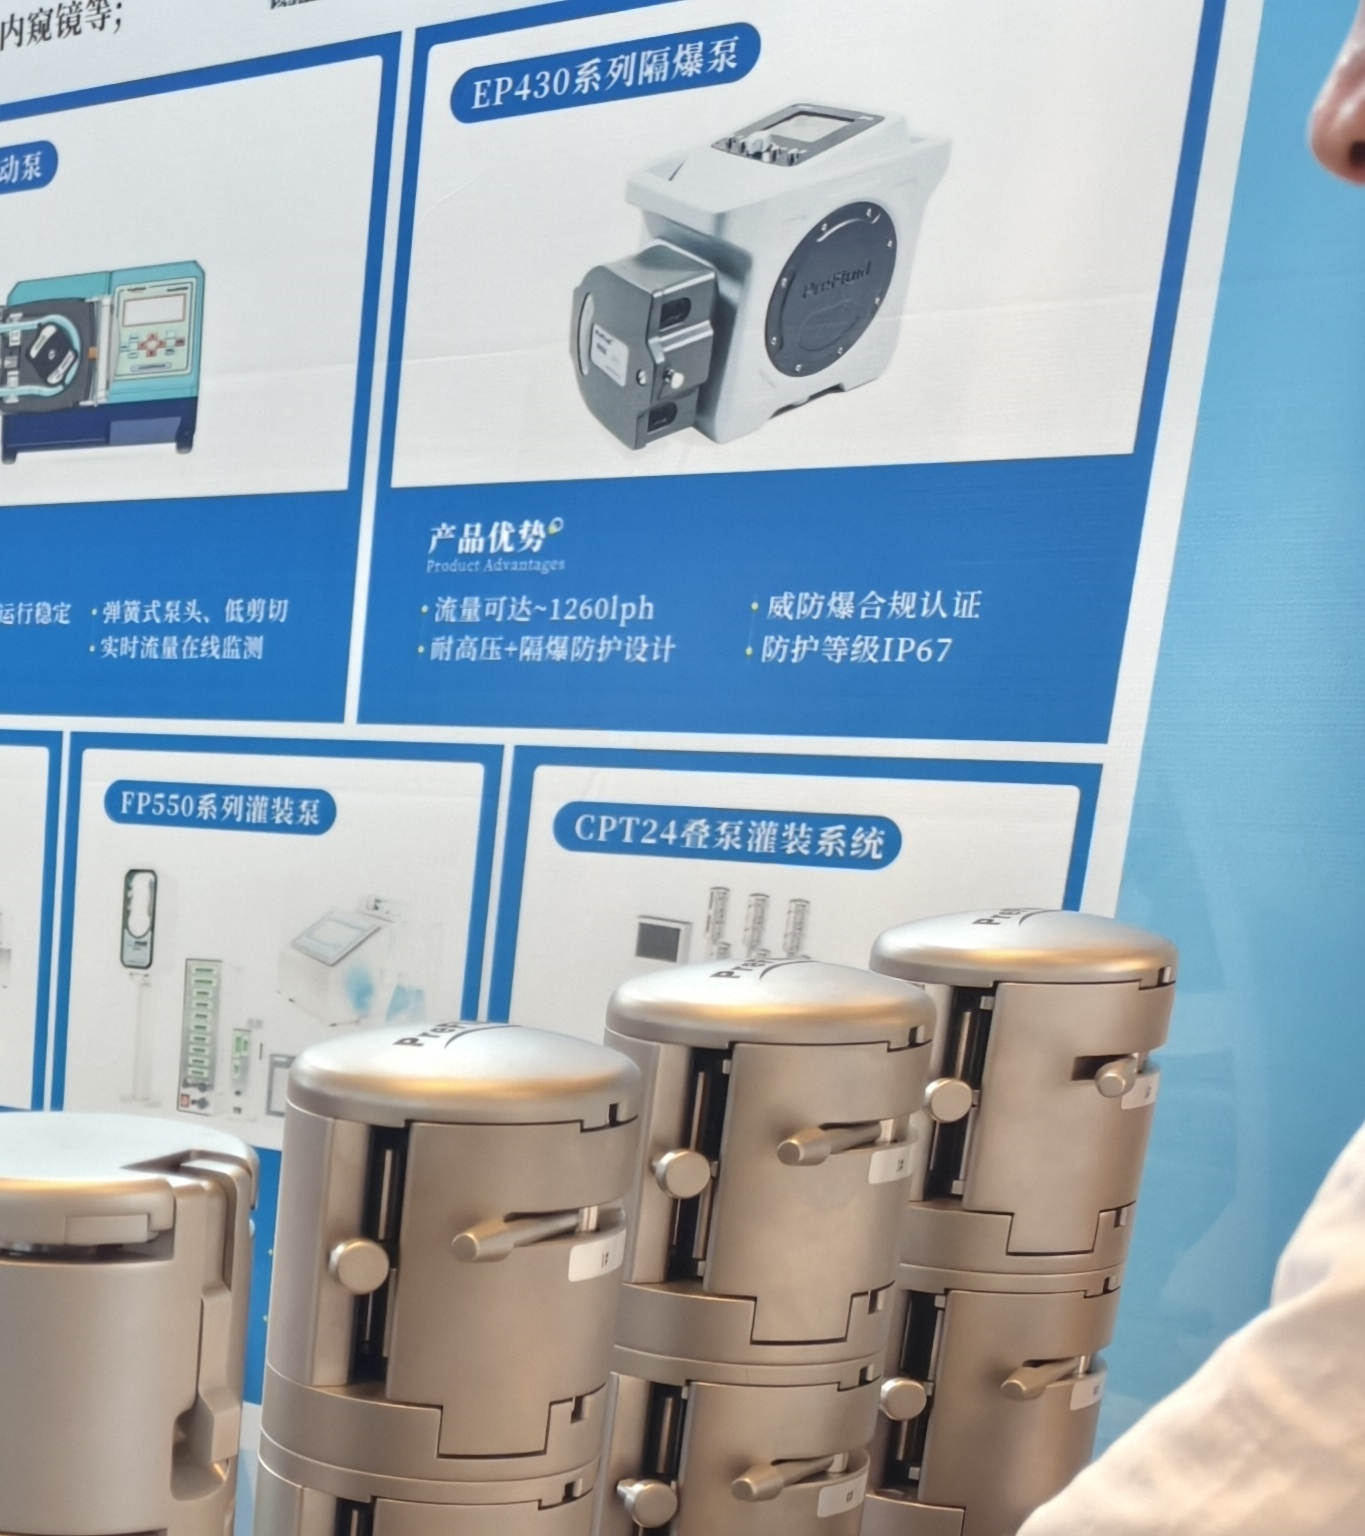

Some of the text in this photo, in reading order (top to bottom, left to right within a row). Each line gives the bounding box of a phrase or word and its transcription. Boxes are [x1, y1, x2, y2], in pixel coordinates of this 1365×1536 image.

[472, 35, 739, 110] EP430系列隔爆泵
[428, 520, 546, 555] 产品优势
[426, 557, 565, 575] Product Advantages
[767, 588, 982, 620] 威防爆合规认证
[100, 635, 264, 661] 实时流量在线监测
[430, 635, 676, 664] 耐高压+隔爆防护设计
[760, 635, 953, 664] 防护等级IP67
[120, 789, 321, 827] FP550系列灌装泵
[574, 814, 886, 861] CPT24叠泵灌装系统
